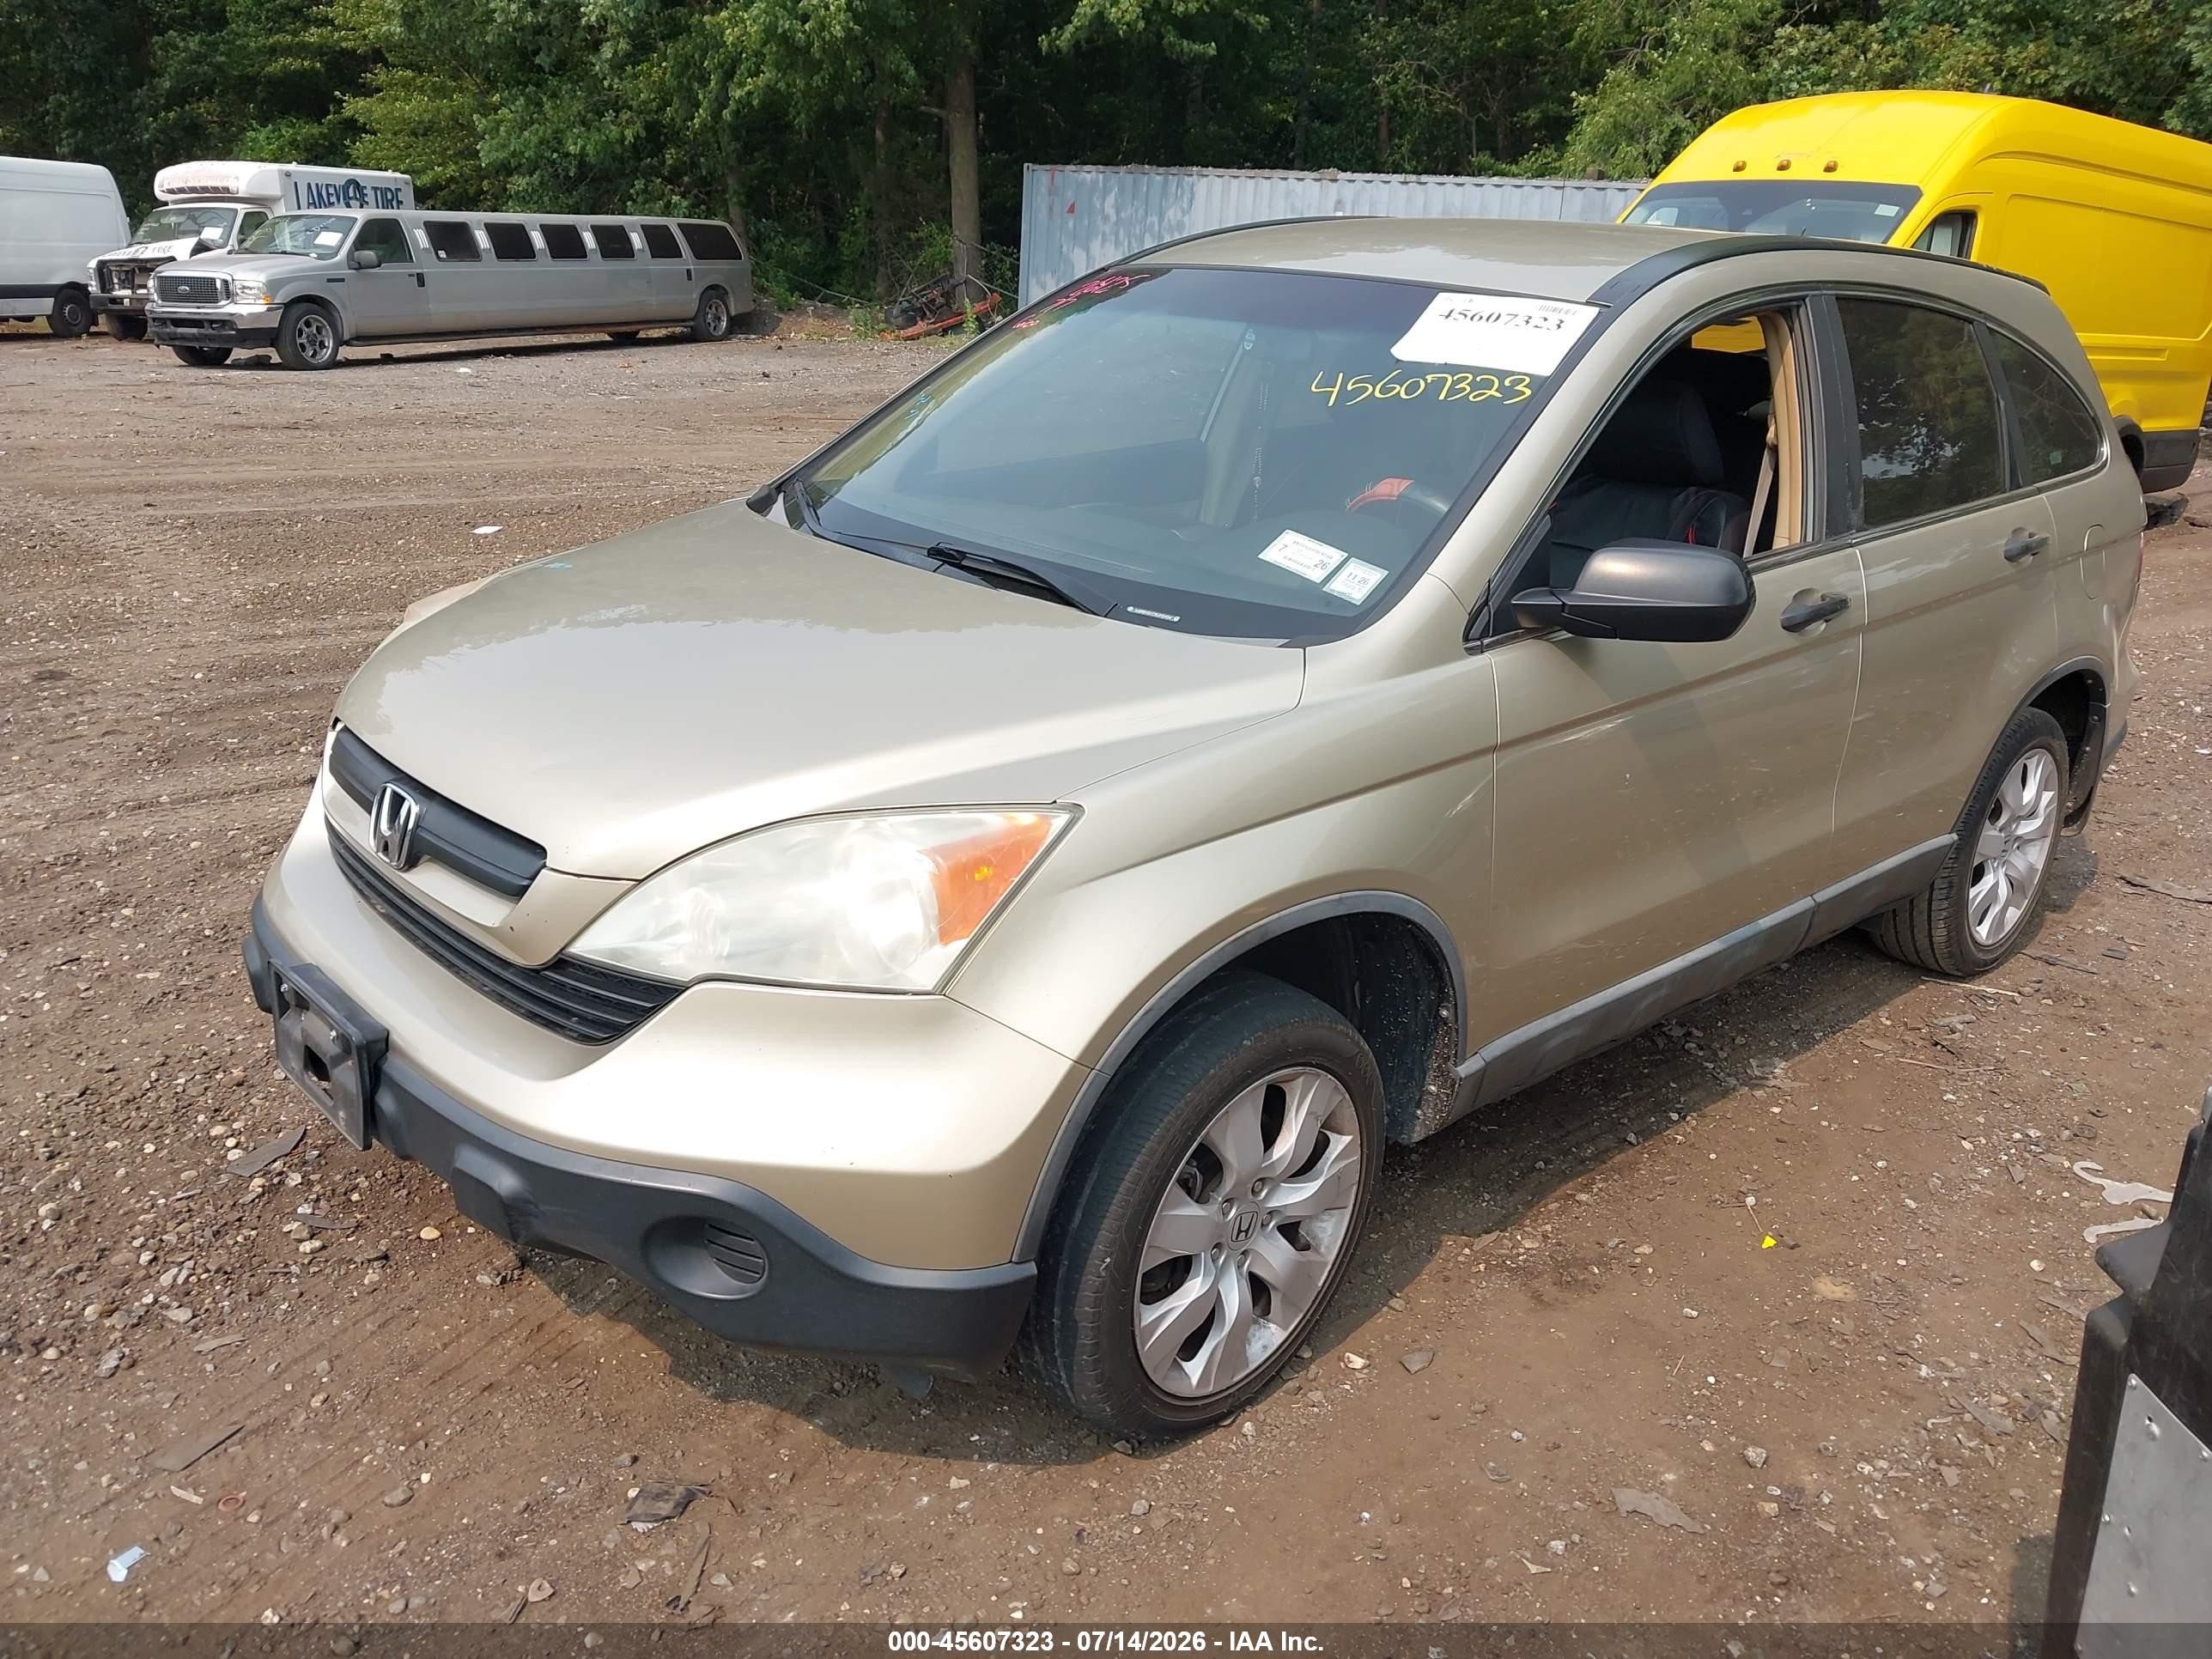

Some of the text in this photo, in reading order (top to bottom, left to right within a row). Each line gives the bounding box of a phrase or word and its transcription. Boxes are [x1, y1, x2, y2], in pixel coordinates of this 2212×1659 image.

[370, 185, 408, 210] TIRE
[1438, 307, 1565, 331] 45607323
[1310, 369, 1533, 407] 45607323
[1314, 559, 1331, 571] 26
